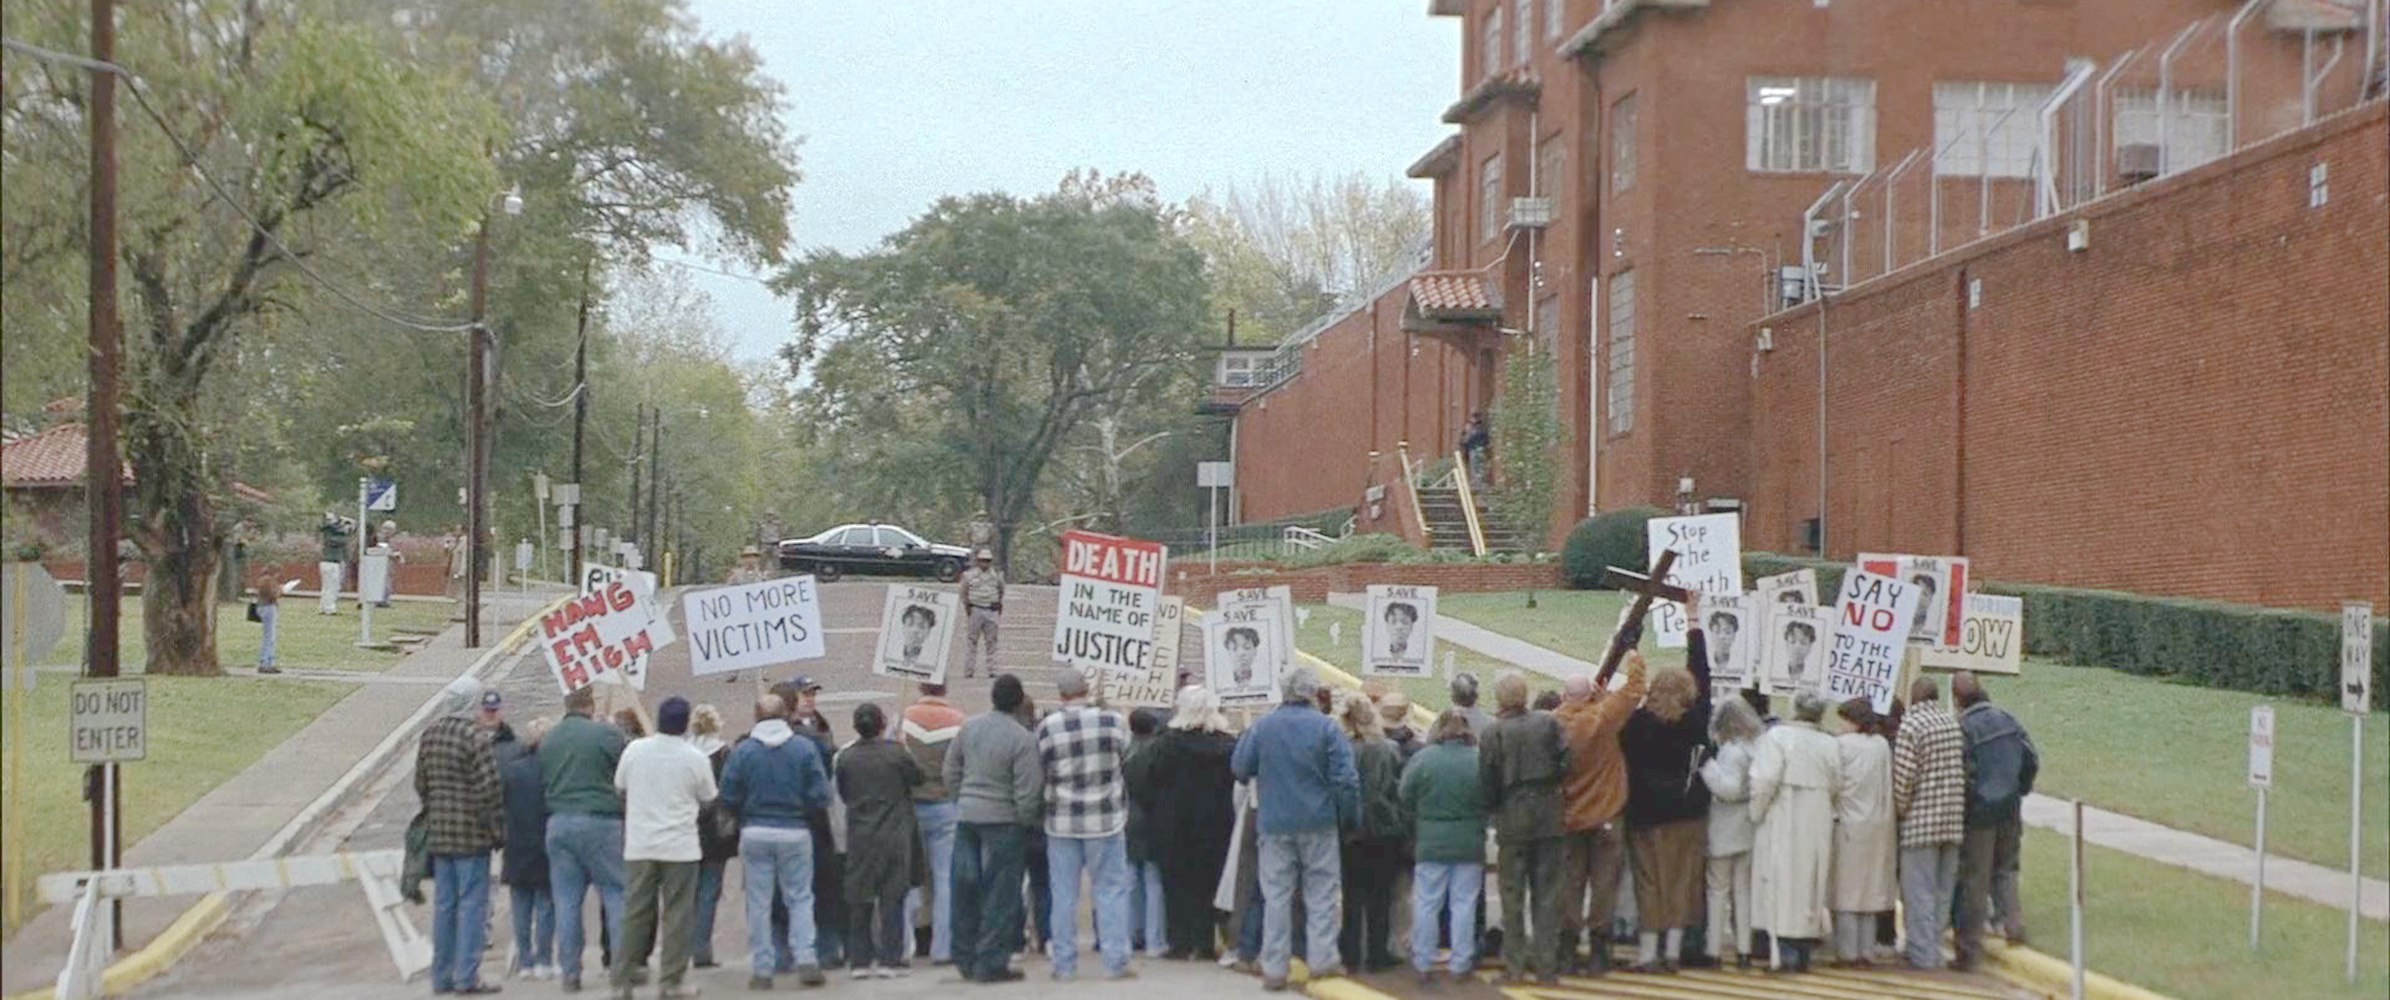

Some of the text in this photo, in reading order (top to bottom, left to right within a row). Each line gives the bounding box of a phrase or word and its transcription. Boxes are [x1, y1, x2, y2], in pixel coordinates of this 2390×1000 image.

[1667, 522, 1707, 546] Stop
[1066, 539, 1158, 585] DEATH
[701, 580, 811, 621] NO MORE
[907, 588, 940, 604] SAVE
[1073, 583, 1143, 608] IN THE
[1237, 589, 1267, 601] SAVE
[1387, 587, 1418, 599] SAVE
[1710, 596, 1739, 608] SAVE
[1848, 574, 1903, 608] SAY
[540, 582, 635, 638] HANG
[1068, 601, 1150, 627] NAME OF
[1157, 602, 1178, 620] ND
[1223, 609, 1257, 621] SAVE
[1787, 604, 1817, 619] SAVE
[1841, 601, 1895, 632] NO
[552, 623, 603, 665] EM
[693, 614, 808, 661] VICTIMS
[1057, 627, 1151, 669] JUSTICE
[1834, 632, 1890, 659] TO THE
[1963, 618, 2013, 658] OW
[561, 629, 653, 690] HIGH
[1827, 674, 1890, 703] ENALTY
[75, 690, 142, 715] DO NOT
[77, 726, 139, 751] ENTER
